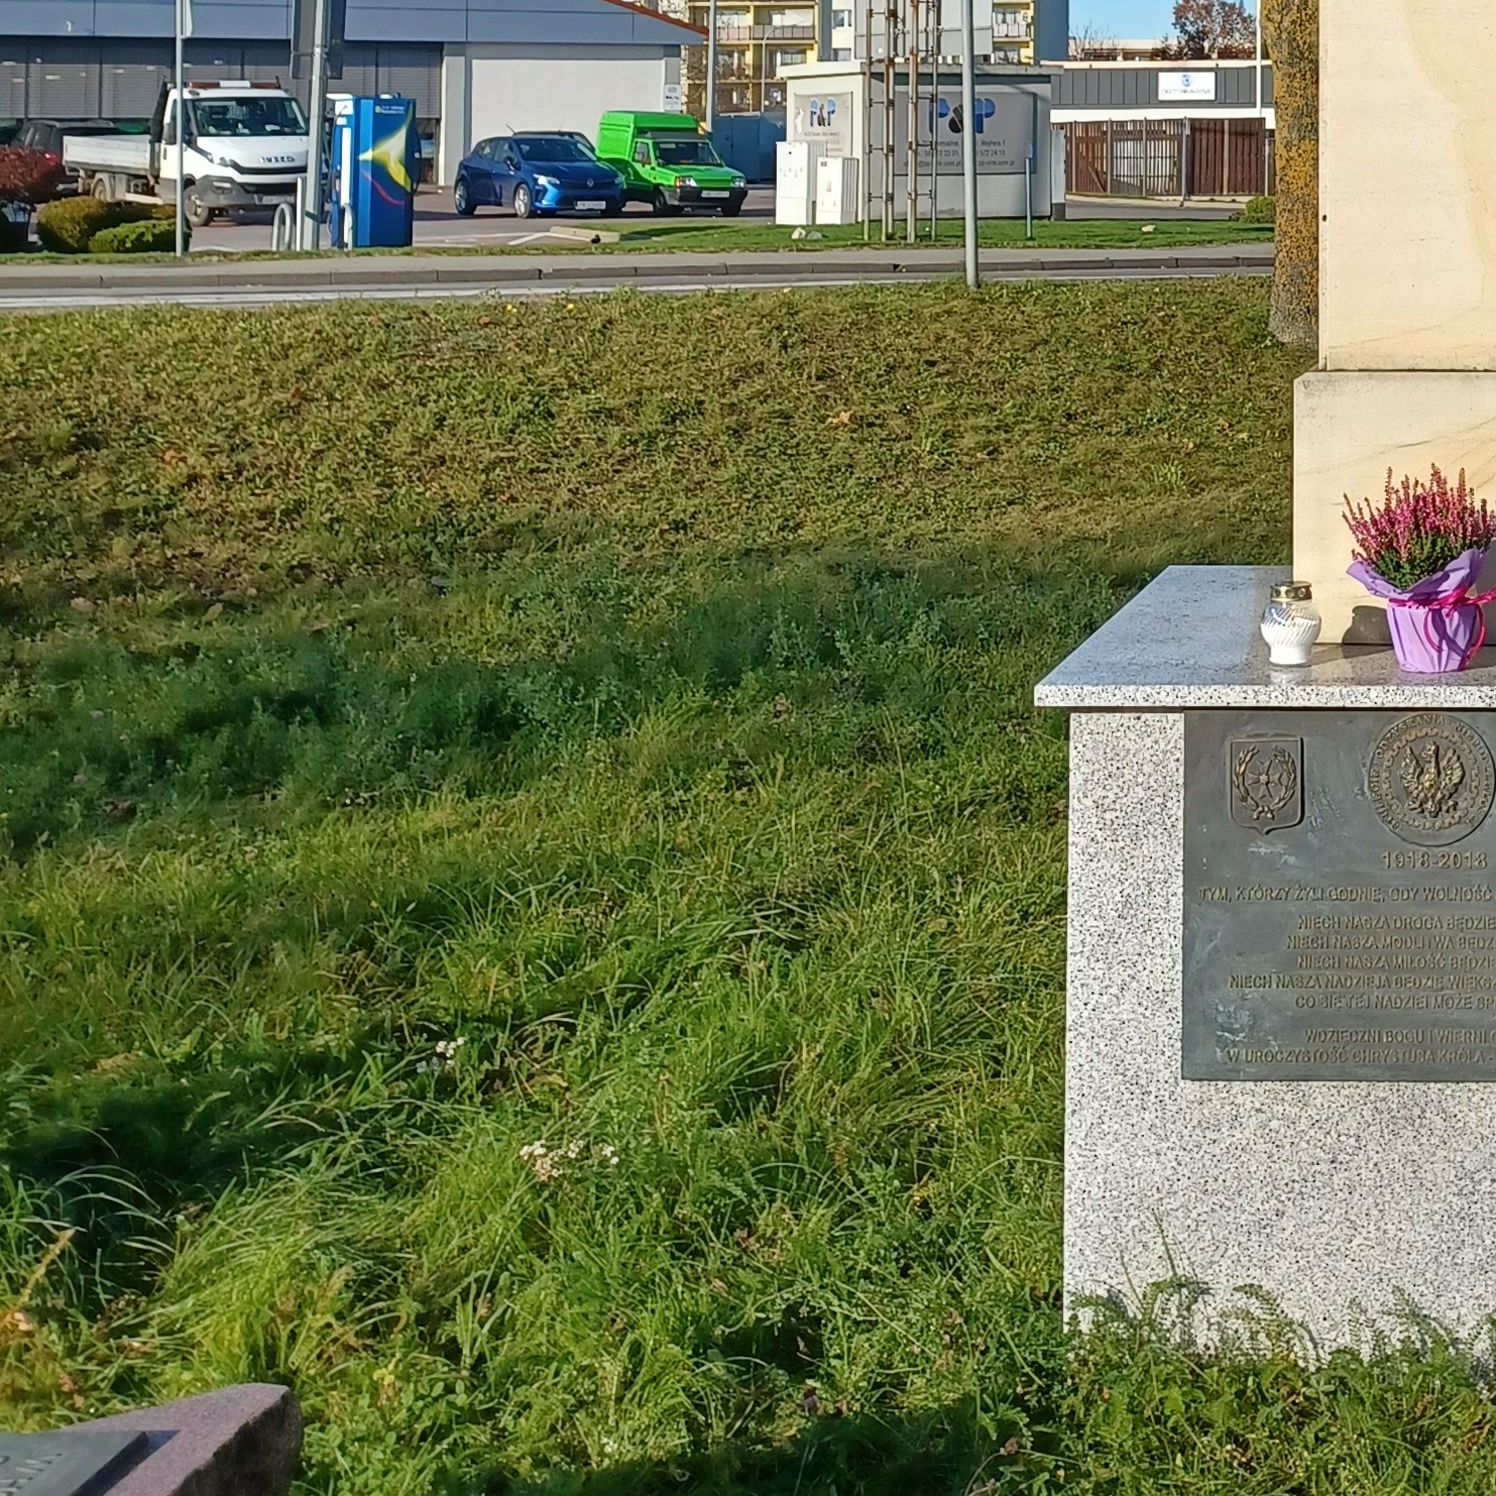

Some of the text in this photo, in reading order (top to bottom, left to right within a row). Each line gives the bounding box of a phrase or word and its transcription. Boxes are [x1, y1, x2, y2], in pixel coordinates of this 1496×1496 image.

[1382, 850, 1488, 870] 1918-2018
[1200, 887, 1231, 903] TYM,
[1236, 884, 1290, 902] KTÓRZY
[1328, 887, 1385, 904] GODNIE,
[1423, 884, 1491, 903] WOLNOŚĆ
[1299, 916, 1340, 930] NIECH
[1344, 916, 1389, 930] NASZA
[1393, 916, 1442, 930] DROGA
[1446, 916, 1496, 933] BĘDZIE
[1287, 935, 1330, 950] NIECH
[1333, 935, 1379, 950] NASZA
[1297, 955, 1340, 970] NIECH
[1344, 955, 1389, 970] NASZA
[1393, 953, 1445, 970] MIŁOŚĆ
[1229, 975, 1272, 990] NIECH
[1275, 975, 1321, 990] NASZA
[1325, 975, 1391, 990] NADZIEJA
[1394, 975, 1443, 992] BĘDZIE
[1295, 994, 1316, 1009] CO
[1374, 995, 1428, 1010] NADZIEI
[1431, 992, 1472, 1010] MOŻE
[1305, 1029, 1380, 1045] WDZIĘCZNI
[1385, 1029, 1424, 1043] BOGU
[1436, 1030, 1486, 1044] WIERNI
[1227, 1048, 1241, 1063] W
[1244, 1044, 1349, 1063] UROCZYSTOŚĆ
[1352, 1048, 1436, 1064] CHRYSTUSA
[1439, 1046, 1485, 1064] KRÓLA
